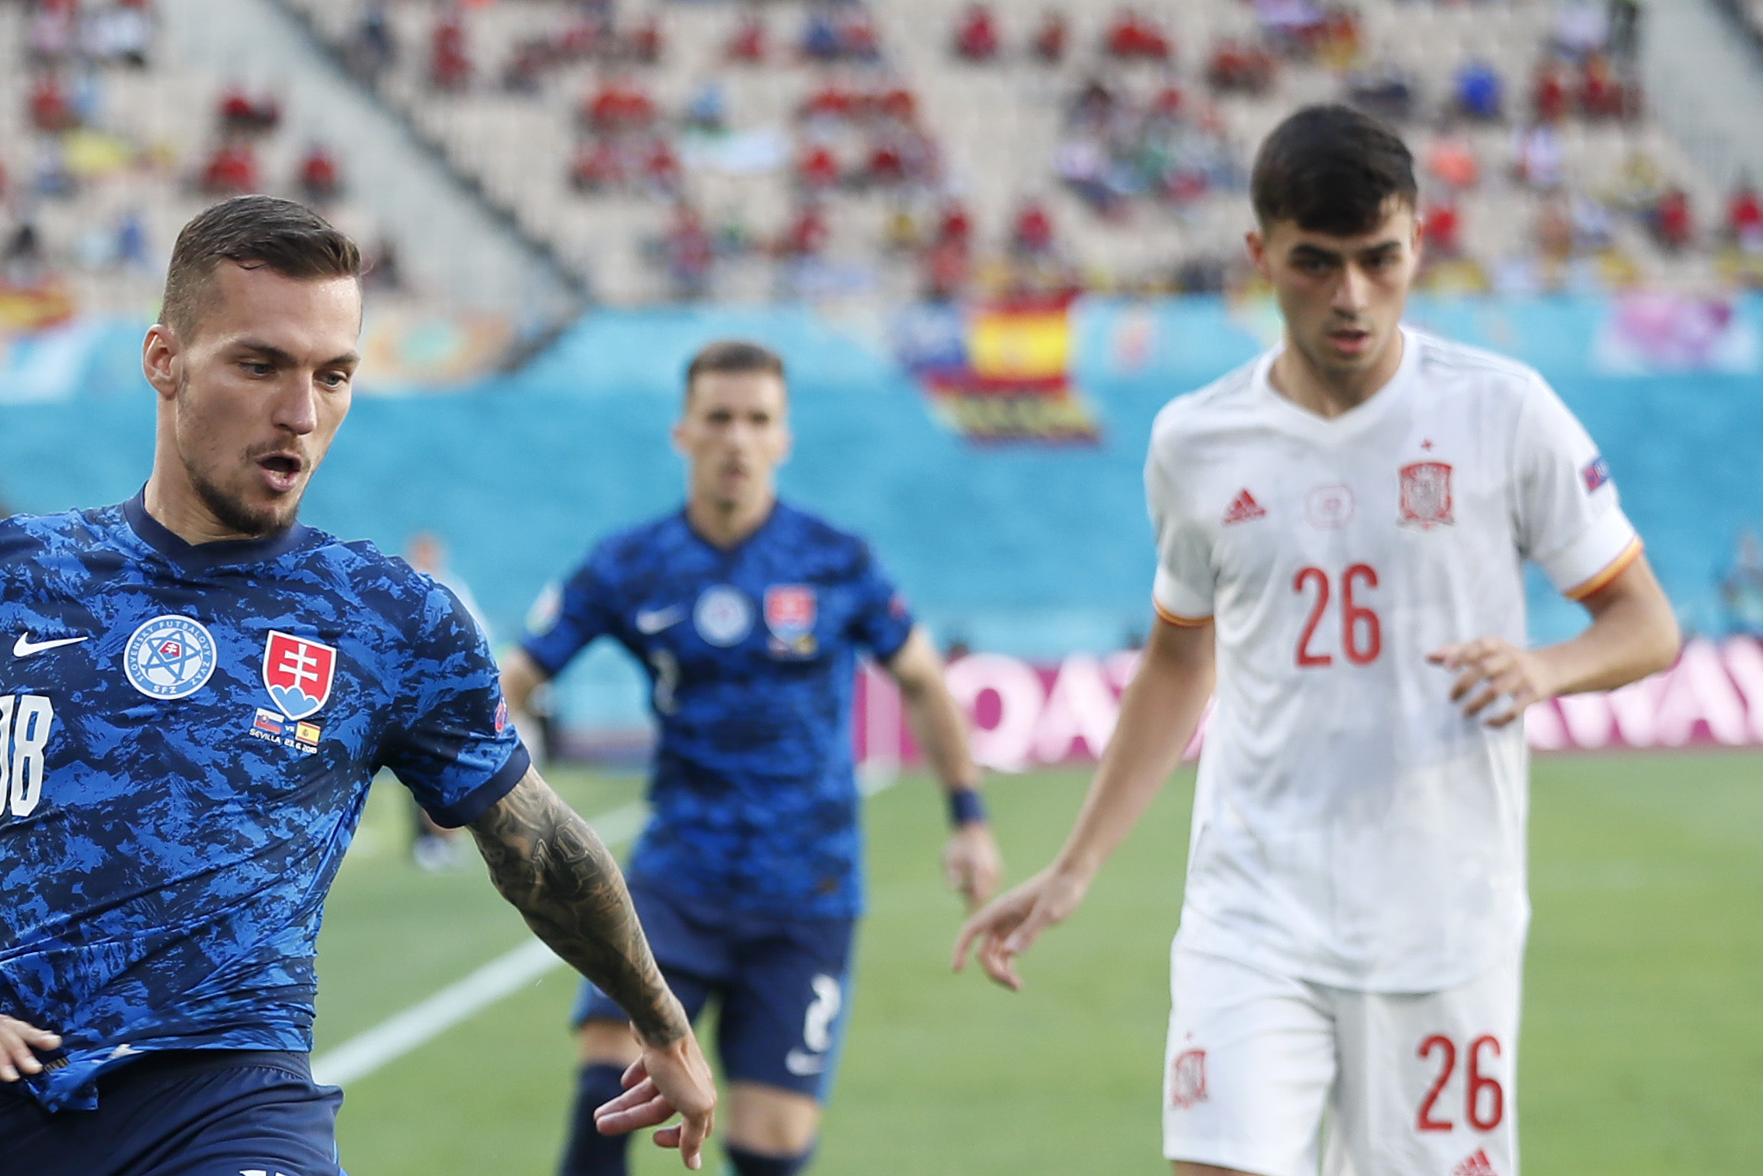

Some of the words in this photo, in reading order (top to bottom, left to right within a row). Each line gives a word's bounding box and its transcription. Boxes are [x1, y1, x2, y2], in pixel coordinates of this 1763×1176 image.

[1293, 562, 1382, 668] 26
[152, 685, 177, 694] SFZ
[249, 728, 281, 743] SEVILLA
[803, 973, 842, 1053] 2
[1417, 1034, 1504, 1133] 26
